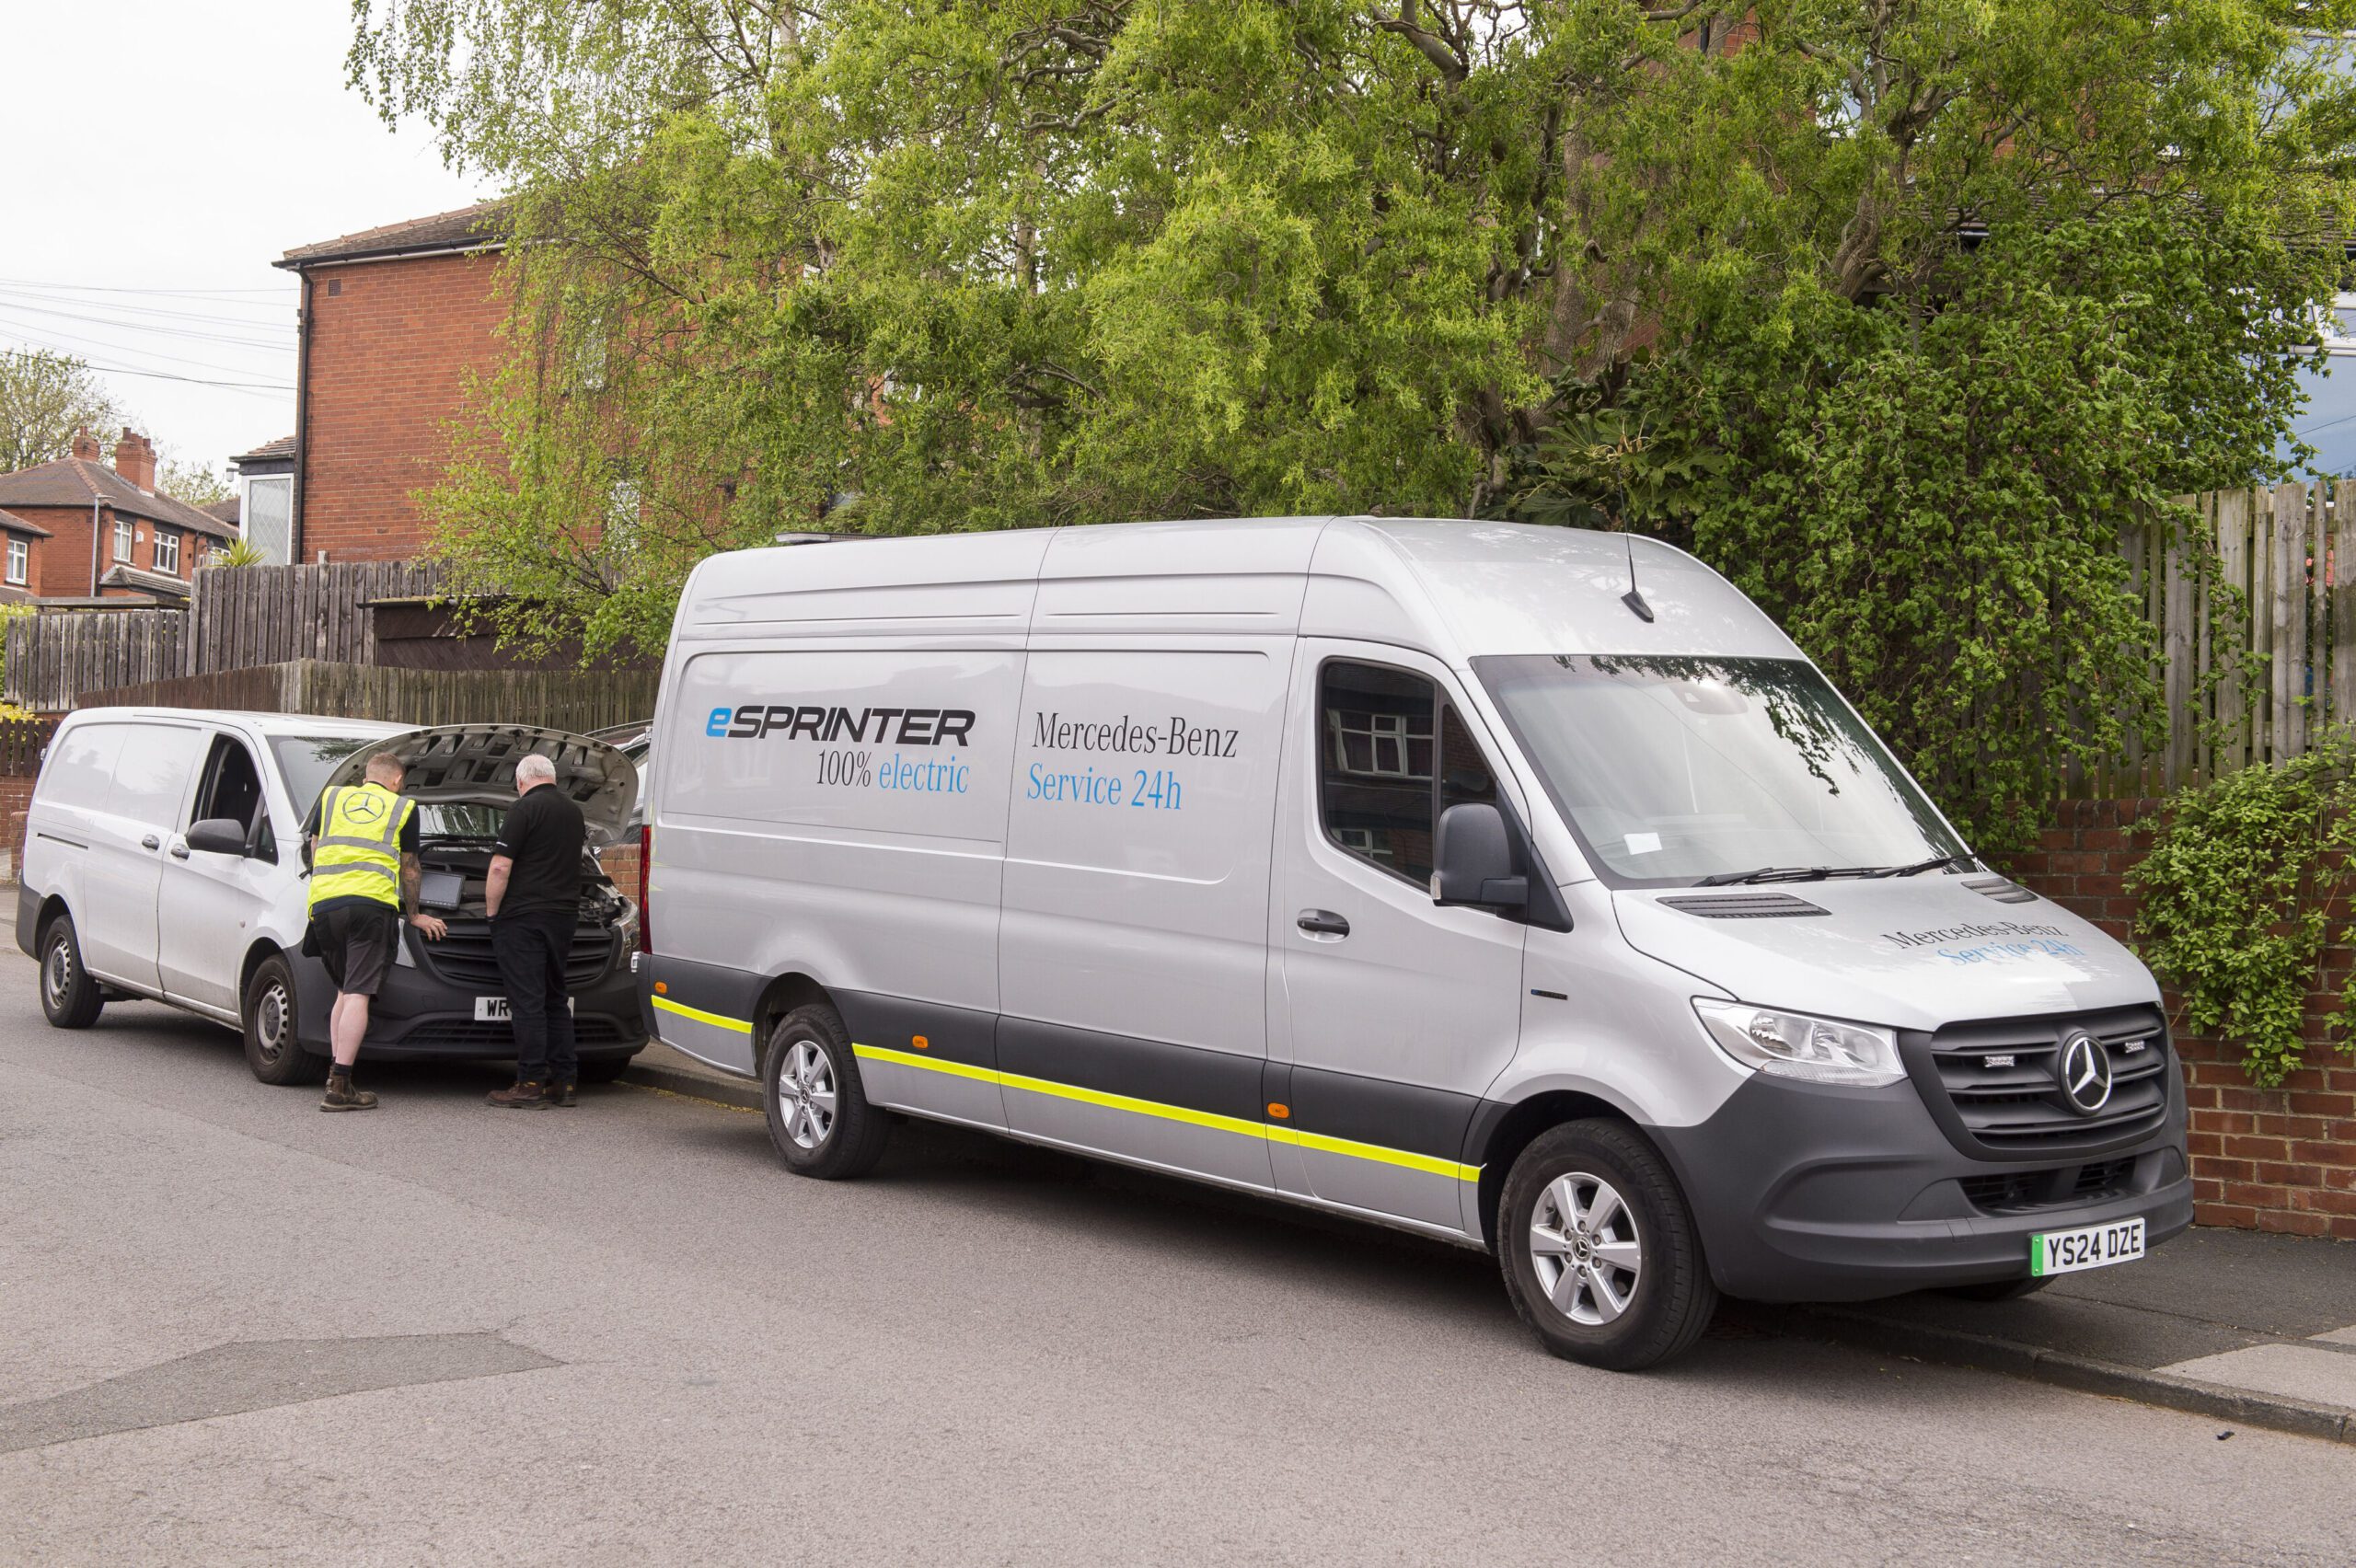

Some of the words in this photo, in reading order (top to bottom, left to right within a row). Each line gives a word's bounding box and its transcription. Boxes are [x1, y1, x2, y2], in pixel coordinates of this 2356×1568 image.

[706, 705, 976, 746] eSPRINTER
[1032, 711, 1239, 757] Mercedes-Benz
[816, 748, 872, 788] 100%
[879, 753, 969, 793] electric
[1027, 762, 1122, 805] Service
[1131, 769, 1182, 810] 24h
[1880, 921, 2069, 949] Mercedes-Benz
[1937, 941, 2032, 965] Service
[2030, 939, 2085, 955] 24h
[487, 999, 509, 1017] WR
[2049, 1231, 2101, 1267] YS24
[2108, 1224, 2141, 1259] DZE
